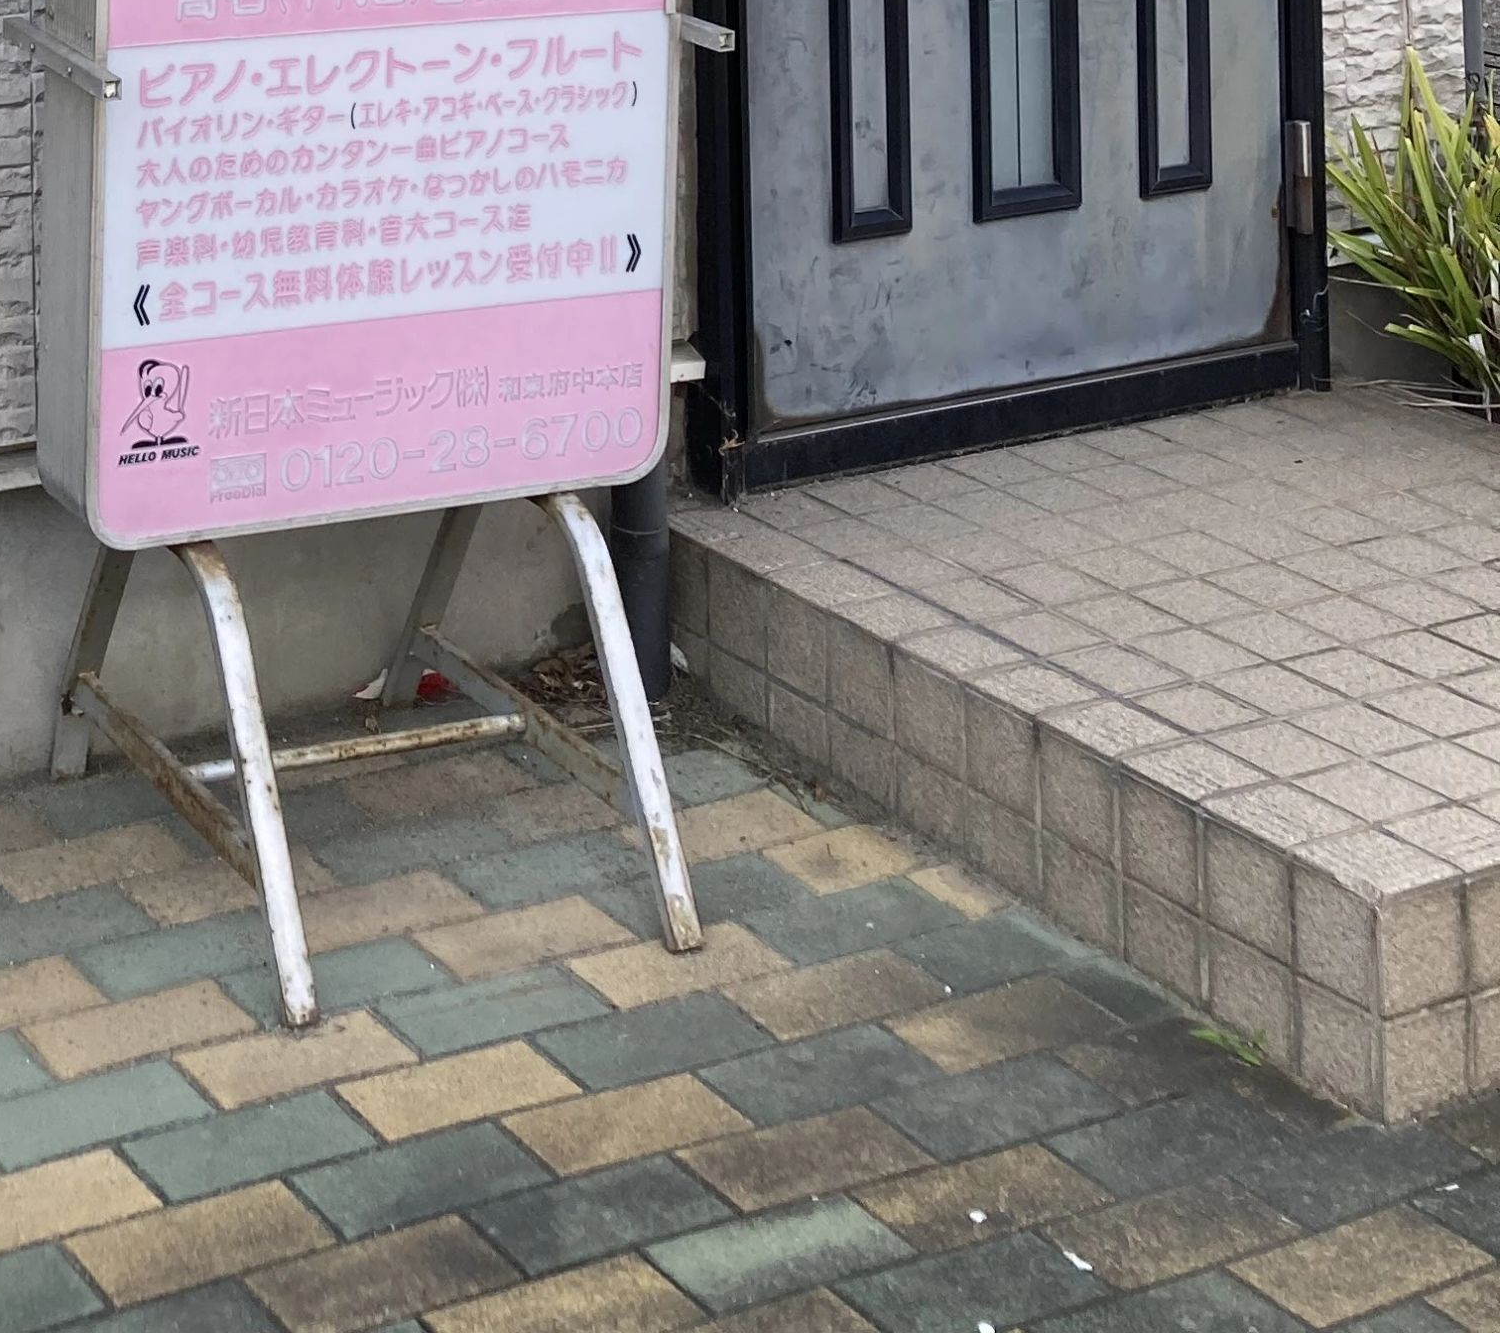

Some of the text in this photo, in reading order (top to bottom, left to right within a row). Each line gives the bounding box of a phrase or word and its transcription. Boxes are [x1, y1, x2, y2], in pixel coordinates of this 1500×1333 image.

[138, 30, 644, 109] ピアノ・エレクトーン・フルート
[136, 124, 571, 189] 大人のためのカンタン一曲ピアノコース
[135, 156, 630, 230] ヤングボーカル・カラオケ・なつかしのハモニカ
[135, 203, 532, 271] 声楽科・幼児教育科・音大コース迄
[117, 445, 200, 466] HELLO MUSIC
[279, 406, 644, 493] 0120-28-6700
